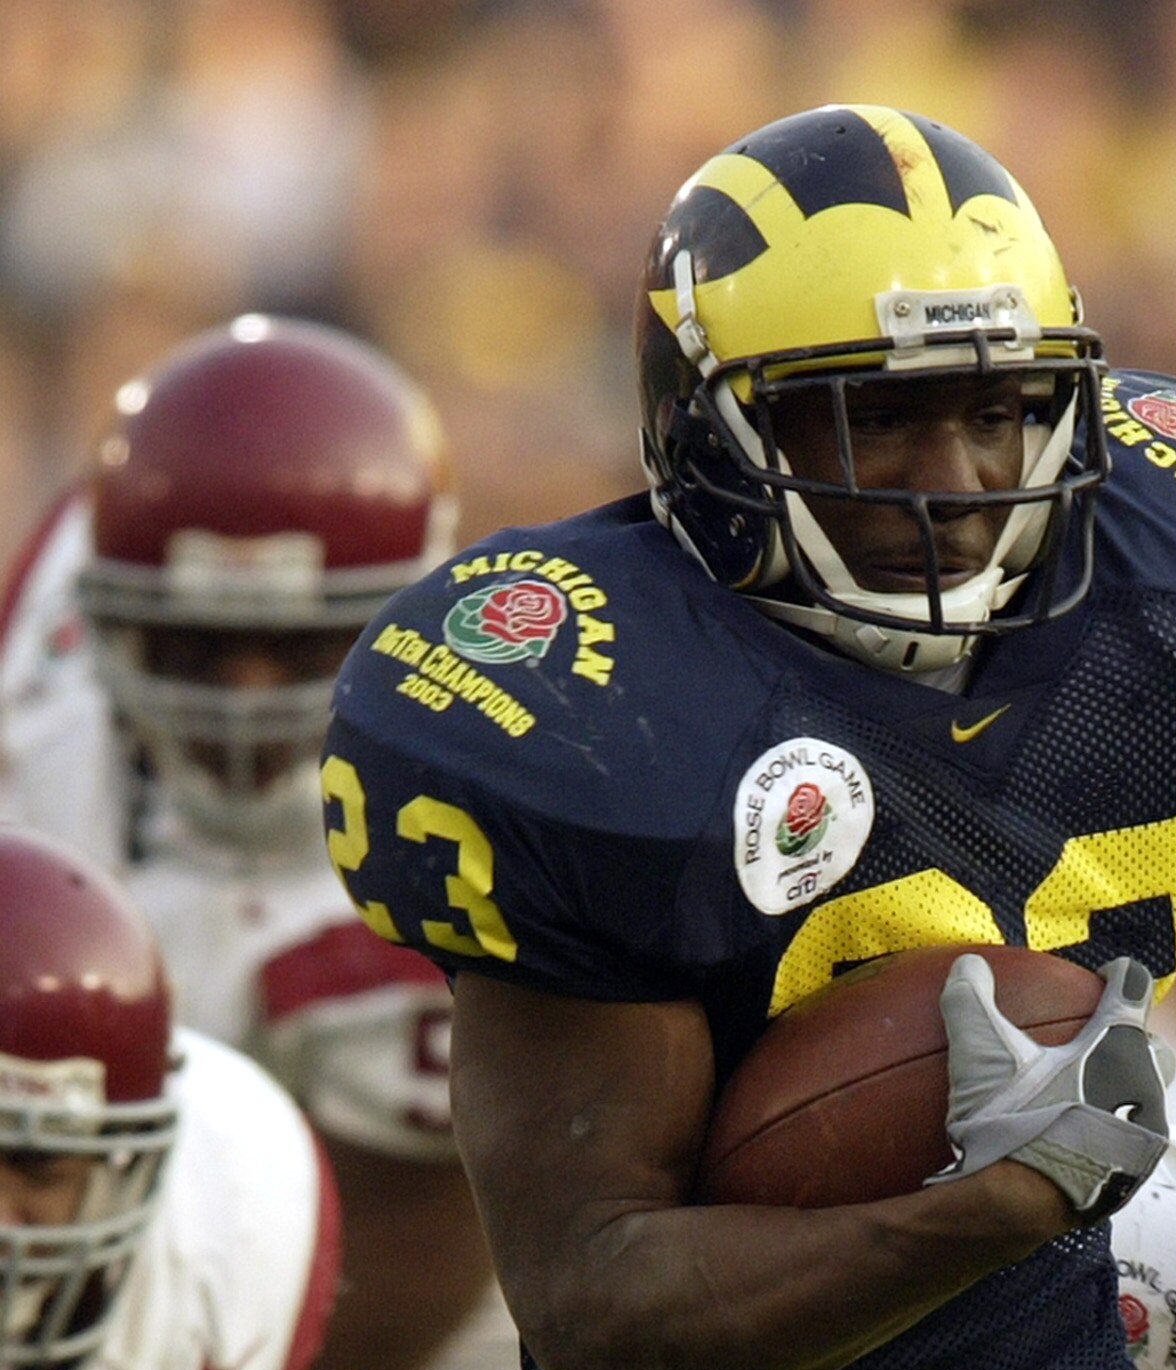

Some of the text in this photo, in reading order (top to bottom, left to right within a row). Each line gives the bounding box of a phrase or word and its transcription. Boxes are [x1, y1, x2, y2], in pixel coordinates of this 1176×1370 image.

[924, 302, 991, 325] MICHIGAN
[450, 550, 616, 687] MICHIGAN
[395, 673, 454, 713] 2003
[418, 644, 537, 738] CHAMPIONS
[744, 747, 866, 865] ROSE BOWL GAME
[320, 755, 518, 963] 23
[1117, 1258, 1163, 1294] OWL
